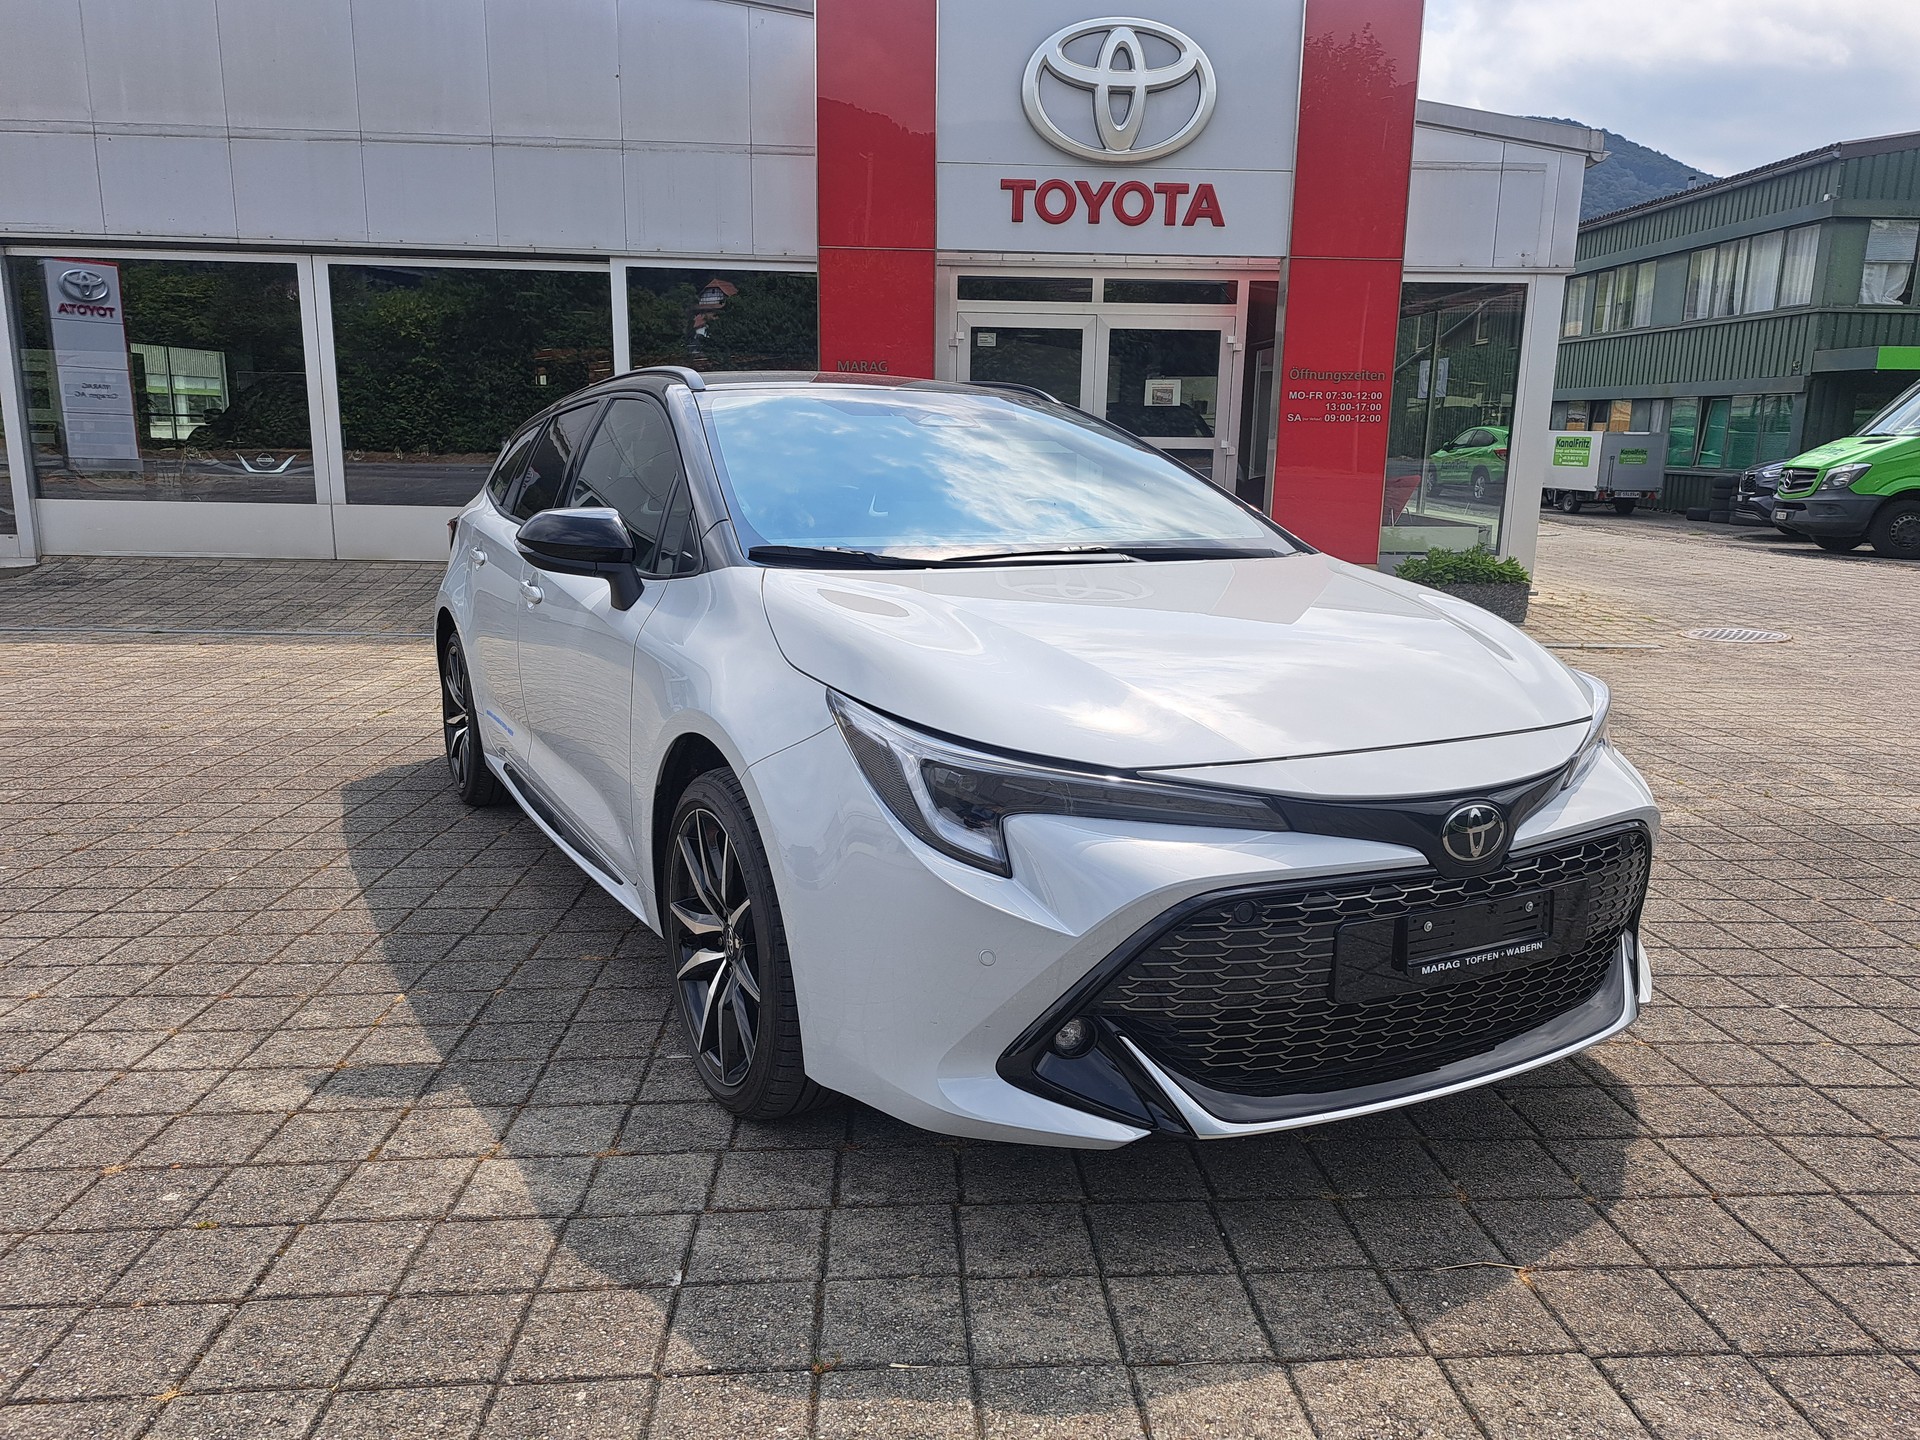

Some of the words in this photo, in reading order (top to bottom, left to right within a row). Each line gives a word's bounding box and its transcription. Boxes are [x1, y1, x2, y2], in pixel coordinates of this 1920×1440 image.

[1000, 178, 1226, 227] TOYOTA
[837, 360, 888, 372] MARAG
[1289, 366, 1386, 383] Öffnungszeiten
[1289, 391, 1323, 400] MO-FR
[1325, 391, 1383, 400] 07:30-12:00
[1325, 403, 1382, 411] 13:00-17:00
[1287, 413, 1302, 422] SA
[1324, 414, 1381, 423] 09:00-12:00
[1556, 438, 1590, 448] KanalFritz
[1421, 960, 1460, 975] MARAG
[1465, 951, 1499, 965] TOFFEN
[1506, 941, 1543, 957] WABERN
